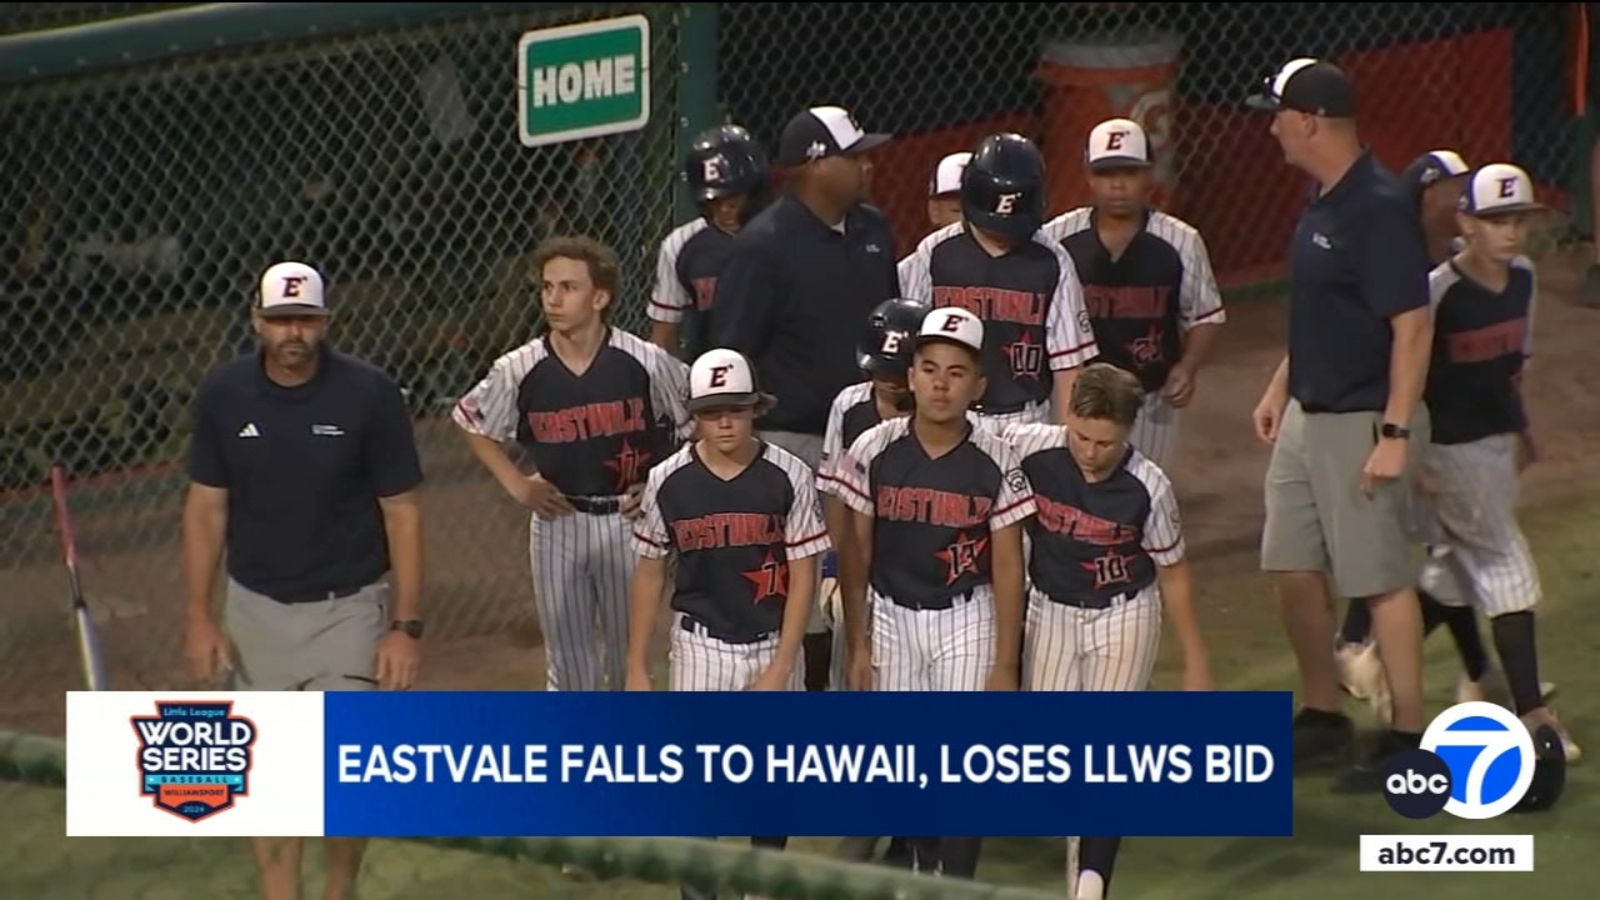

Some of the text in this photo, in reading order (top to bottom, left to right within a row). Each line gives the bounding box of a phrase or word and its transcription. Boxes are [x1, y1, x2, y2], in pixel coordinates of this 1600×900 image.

[533, 54, 635, 108] HOME
[1105, 132, 1124, 151] E
[703, 158, 721, 182] E
[1497, 177, 1518, 198] E
[995, 193, 1017, 214] E
[282, 276, 304, 298] E
[941, 314, 964, 333] E
[881, 331, 902, 354] E
[709, 366, 729, 388] E
